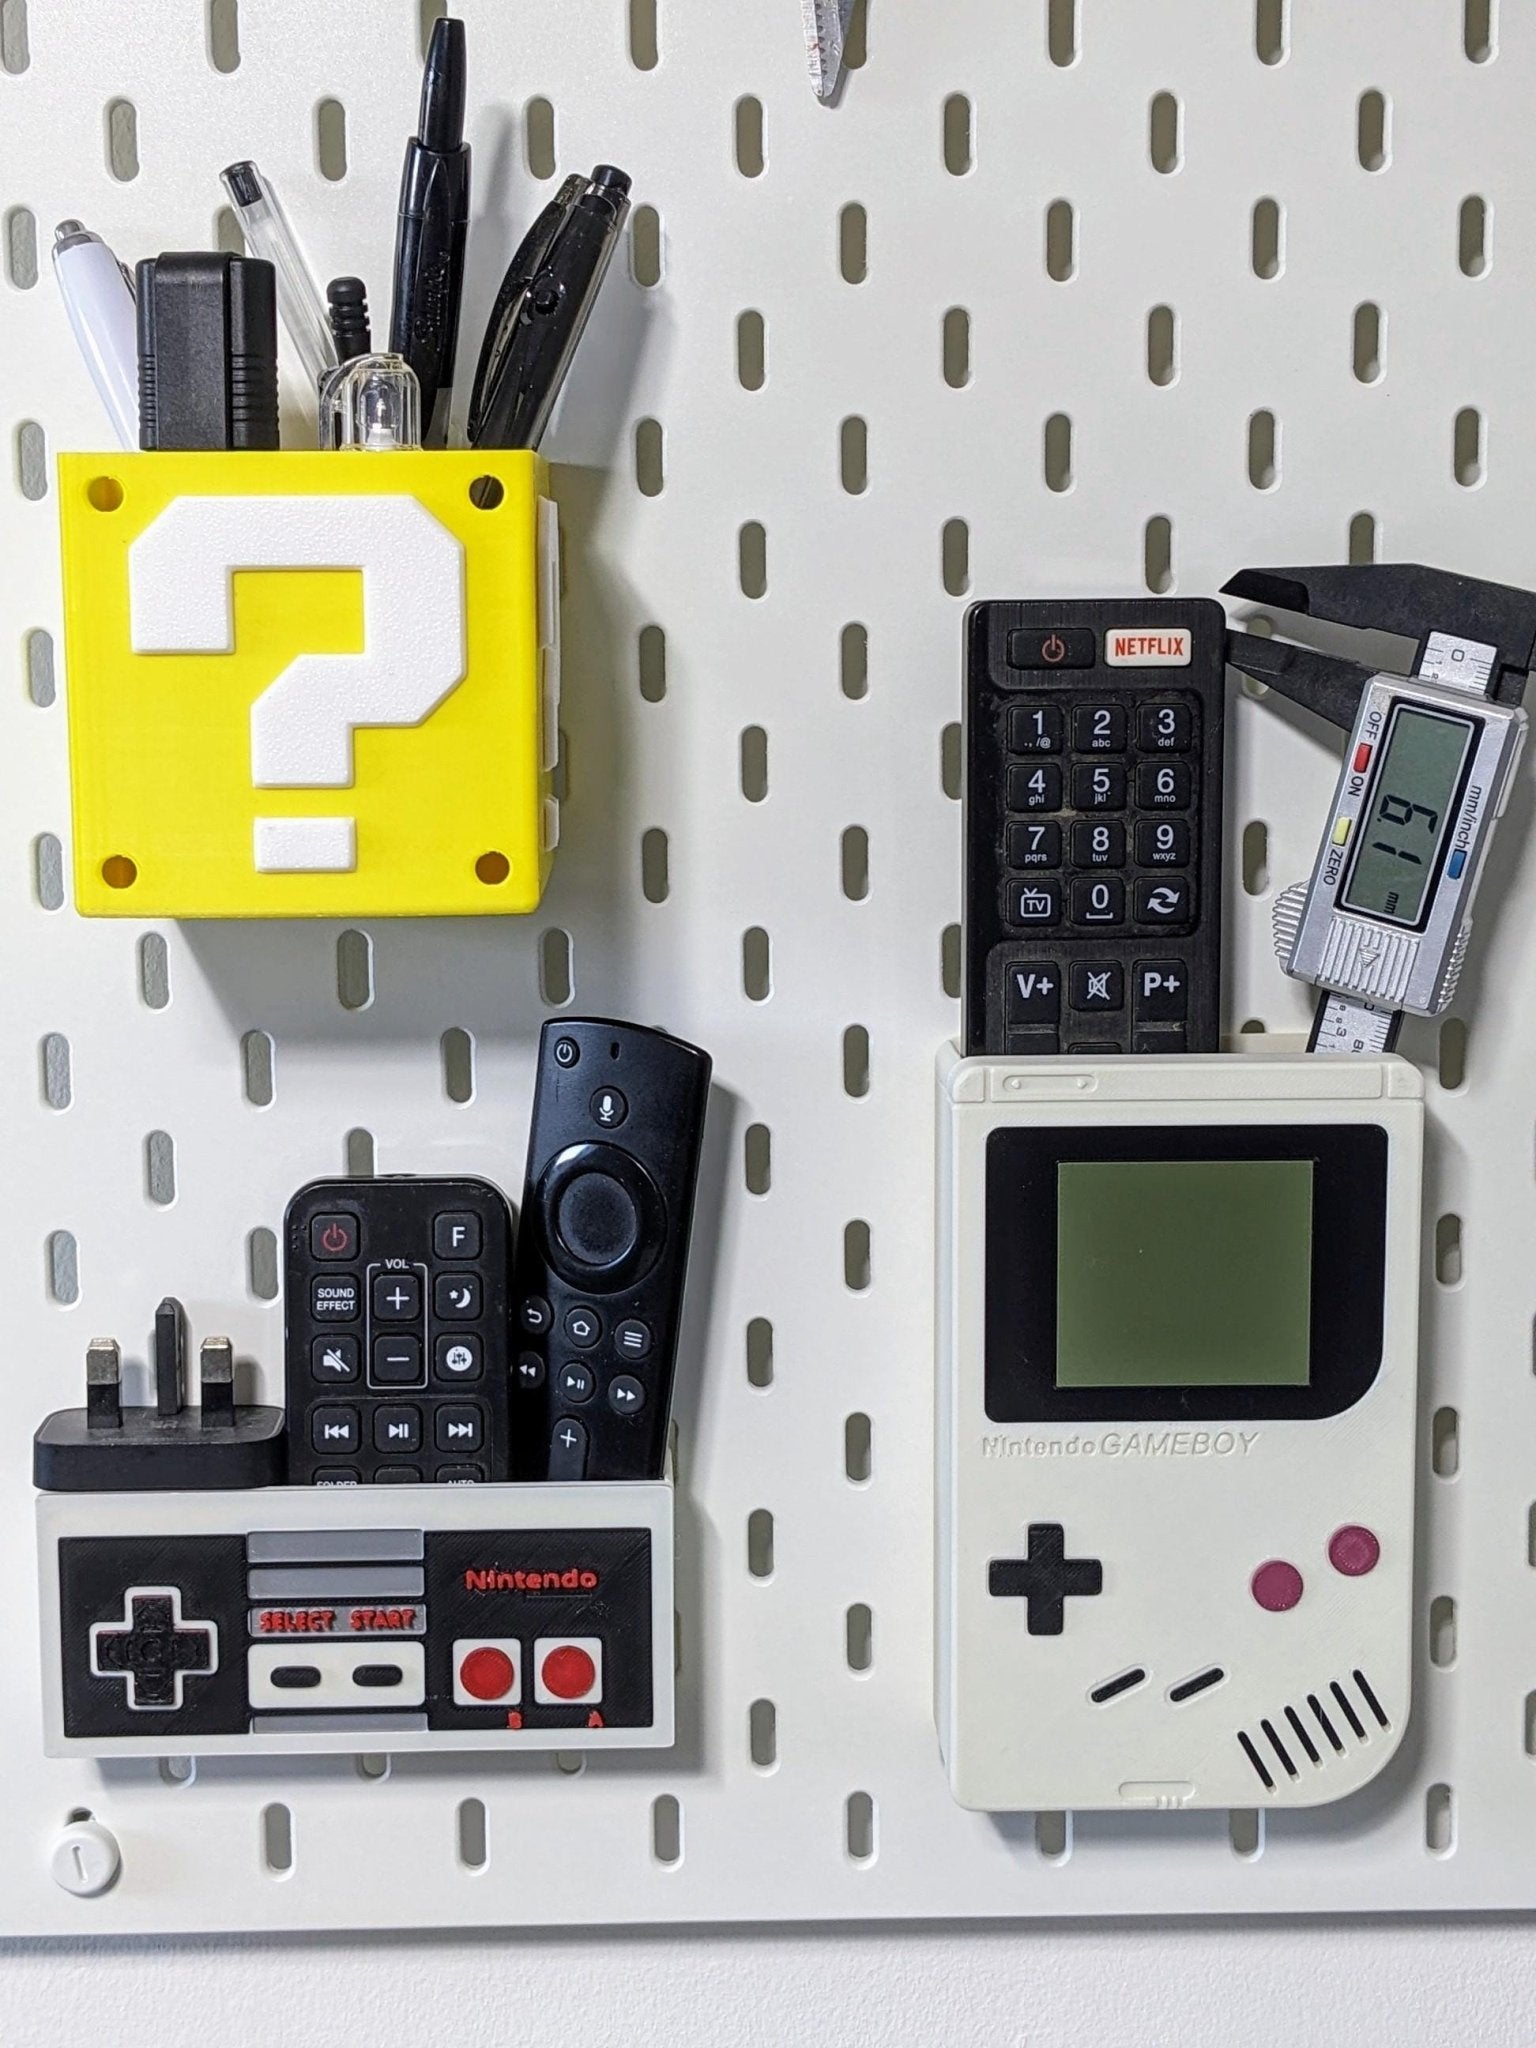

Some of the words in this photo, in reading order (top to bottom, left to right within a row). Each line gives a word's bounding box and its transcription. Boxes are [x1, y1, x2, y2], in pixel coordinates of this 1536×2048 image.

[1114, 637, 1184, 657] NETFLIX
[1032, 710, 1043, 735] 1
[1093, 710, 1111, 735] 2
[1157, 708, 1175, 734] 3
[1367, 711, 1383, 740] OFF
[1091, 738, 1111, 748] abc
[1157, 737, 1175, 747] def
[1028, 769, 1046, 794] 4
[1092, 768, 1110, 793] 5
[1157, 768, 1175, 793] 6
[1348, 775, 1364, 797] ON
[1028, 794, 1045, 805] ghi
[1094, 792, 1107, 804] jkl
[1154, 794, 1176, 803] mno
[1455, 785, 1482, 850] mm/inch
[1028, 826, 1045, 850] 7
[1092, 826, 1110, 851] 8
[1156, 824, 1174, 849] 9
[1024, 852, 1048, 863] pqrs
[1092, 853, 1108, 862] tuv
[1152, 851, 1177, 861] wxyz
[1323, 848, 1344, 886] ZERO
[1026, 900, 1045, 912] TV
[1091, 884, 1109, 909] 0
[1384, 891, 1400, 914] mm
[1016, 973, 1054, 998] V+
[1143, 972, 1180, 996] P+
[1351, 1039, 1364, 1053] 8
[452, 1226, 466, 1247] F
[385, 1259, 410, 1269] VOL
[317, 1288, 355, 1298] SOUND
[316, 1300, 356, 1311] EFFECT
[465, 1568, 598, 1591] Nintendo
[260, 1609, 335, 1633] SELECT
[349, 1608, 417, 1632] START
[587, 1710, 604, 1728] A
